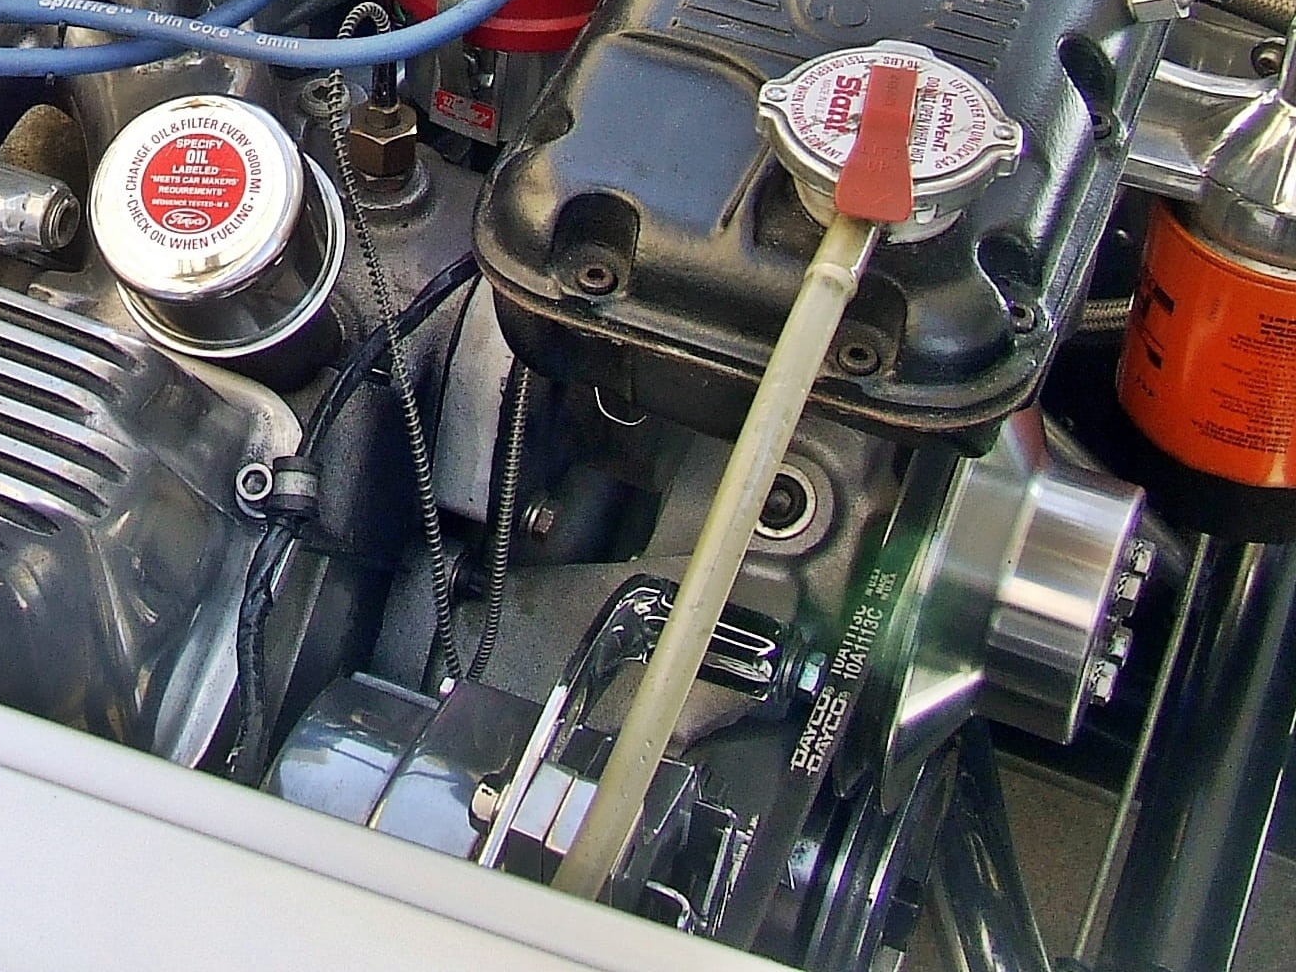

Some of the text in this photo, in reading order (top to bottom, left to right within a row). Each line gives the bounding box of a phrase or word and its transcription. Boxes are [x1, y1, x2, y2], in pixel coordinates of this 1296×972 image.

[146, 11, 182, 29] Twin
[256, 33, 299, 49] 8mm
[845, 55, 864, 65] TEST
[824, 75, 862, 133] Stant
[919, 104, 934, 123] OPEN
[963, 95, 985, 118] LEVER
[181, 118, 218, 130] FILTER
[973, 121, 986, 129] TO
[151, 128, 170, 145] OIL
[176, 139, 224, 149] SPECIFY
[219, 122, 252, 147] EVERY
[912, 125, 930, 147] WHEN
[185, 150, 208, 164] OIL
[245, 148, 261, 175] 6000
[126, 144, 152, 191] CHANGE
[172, 165, 219, 175] LABELED
[249, 179, 261, 193] MI
[127, 199, 254, 250] CHECK OIL WHEN FUELING
[842, 607, 883, 680] 10A1113C
